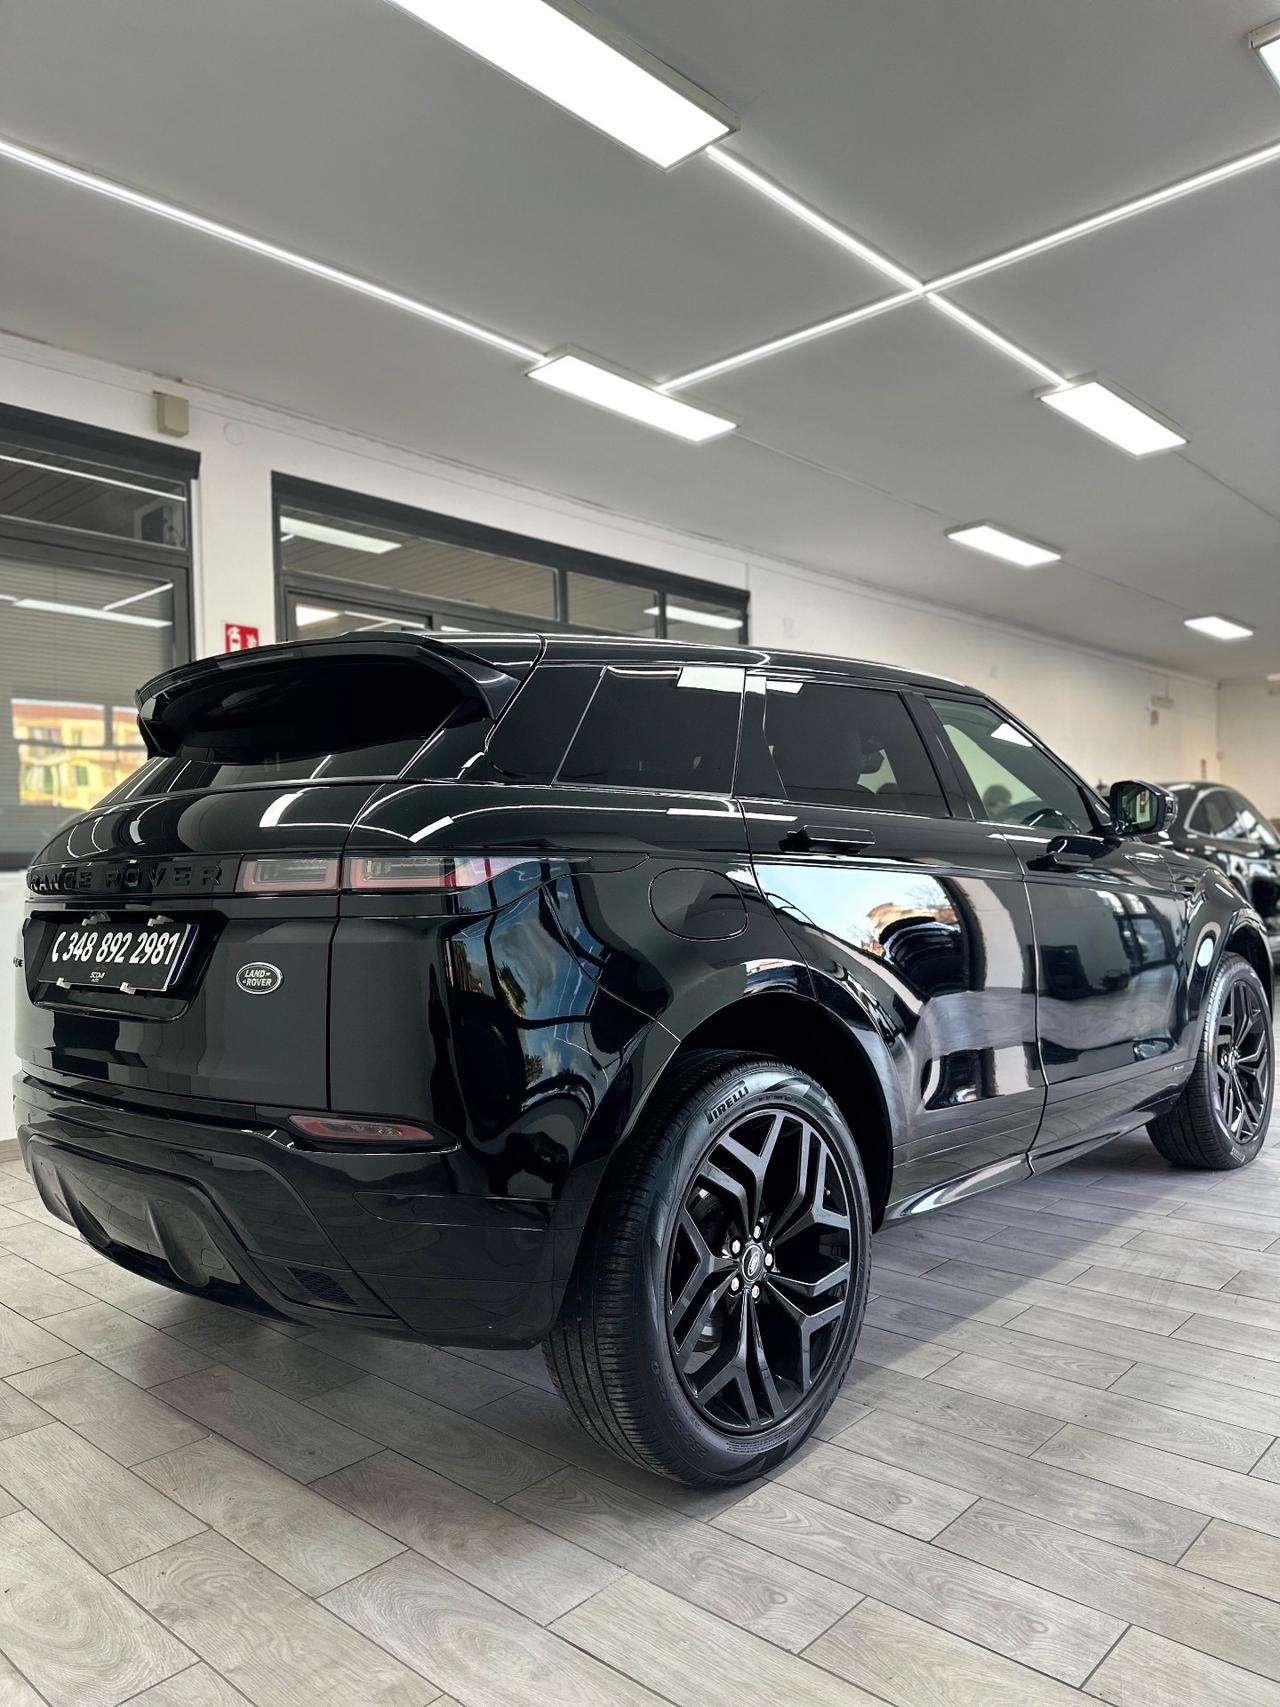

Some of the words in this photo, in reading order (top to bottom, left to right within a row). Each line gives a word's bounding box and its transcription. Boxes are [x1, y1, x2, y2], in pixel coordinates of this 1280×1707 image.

[30, 866, 91, 892] RANGE
[106, 865, 222, 887] ROVER
[62, 931, 98, 962] 348
[95, 931, 132, 963] 892
[128, 932, 180, 965] 2981
[246, 978, 271, 986] ROVER
[703, 1080, 749, 1124] PIRELLI
